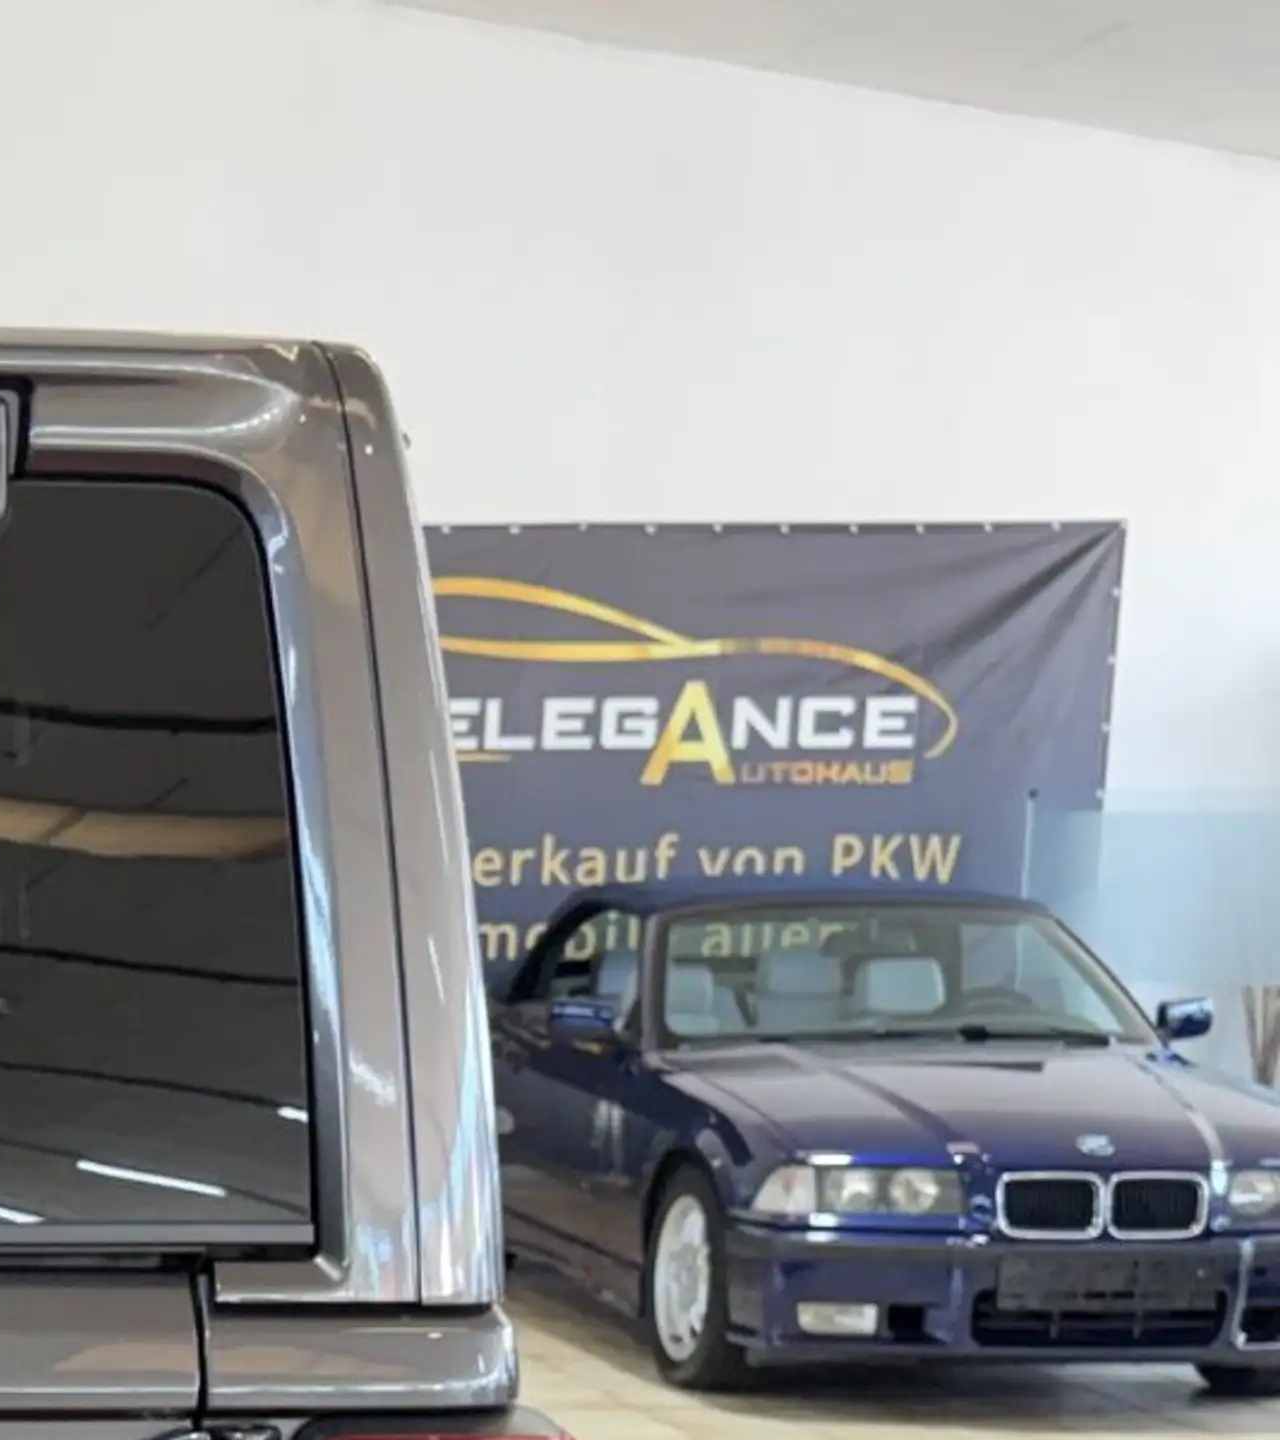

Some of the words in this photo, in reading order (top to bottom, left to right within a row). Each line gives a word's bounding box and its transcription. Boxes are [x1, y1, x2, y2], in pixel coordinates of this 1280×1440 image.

[446, 680, 917, 786] ELEGANCE
[471, 831, 681, 888] erkauf
[697, 844, 806, 877] von
[830, 833, 962, 883] PKW
